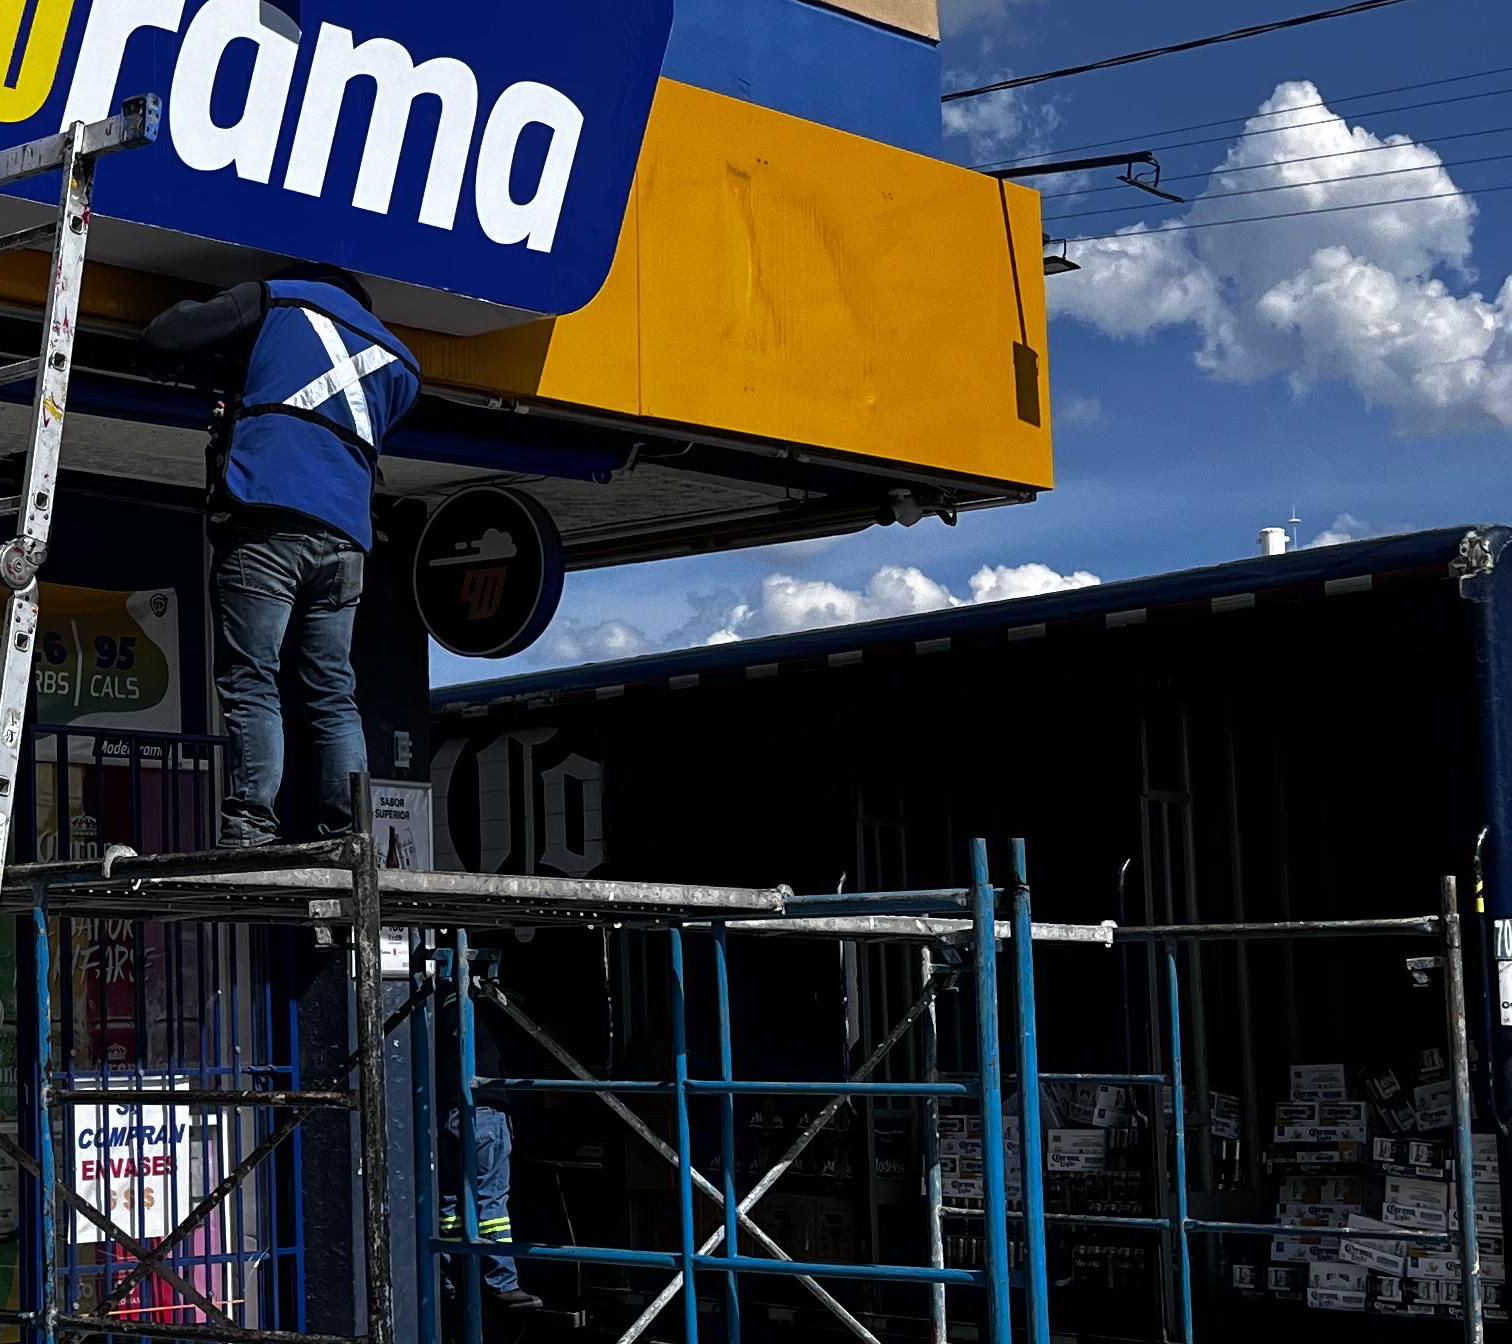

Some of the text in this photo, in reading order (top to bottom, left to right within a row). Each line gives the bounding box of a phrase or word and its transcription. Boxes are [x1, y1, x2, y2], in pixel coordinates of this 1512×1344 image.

[95, 636, 137, 671] 95
[90, 674, 141, 700] CALS
[78, 1123, 186, 1149] COMPRAN
